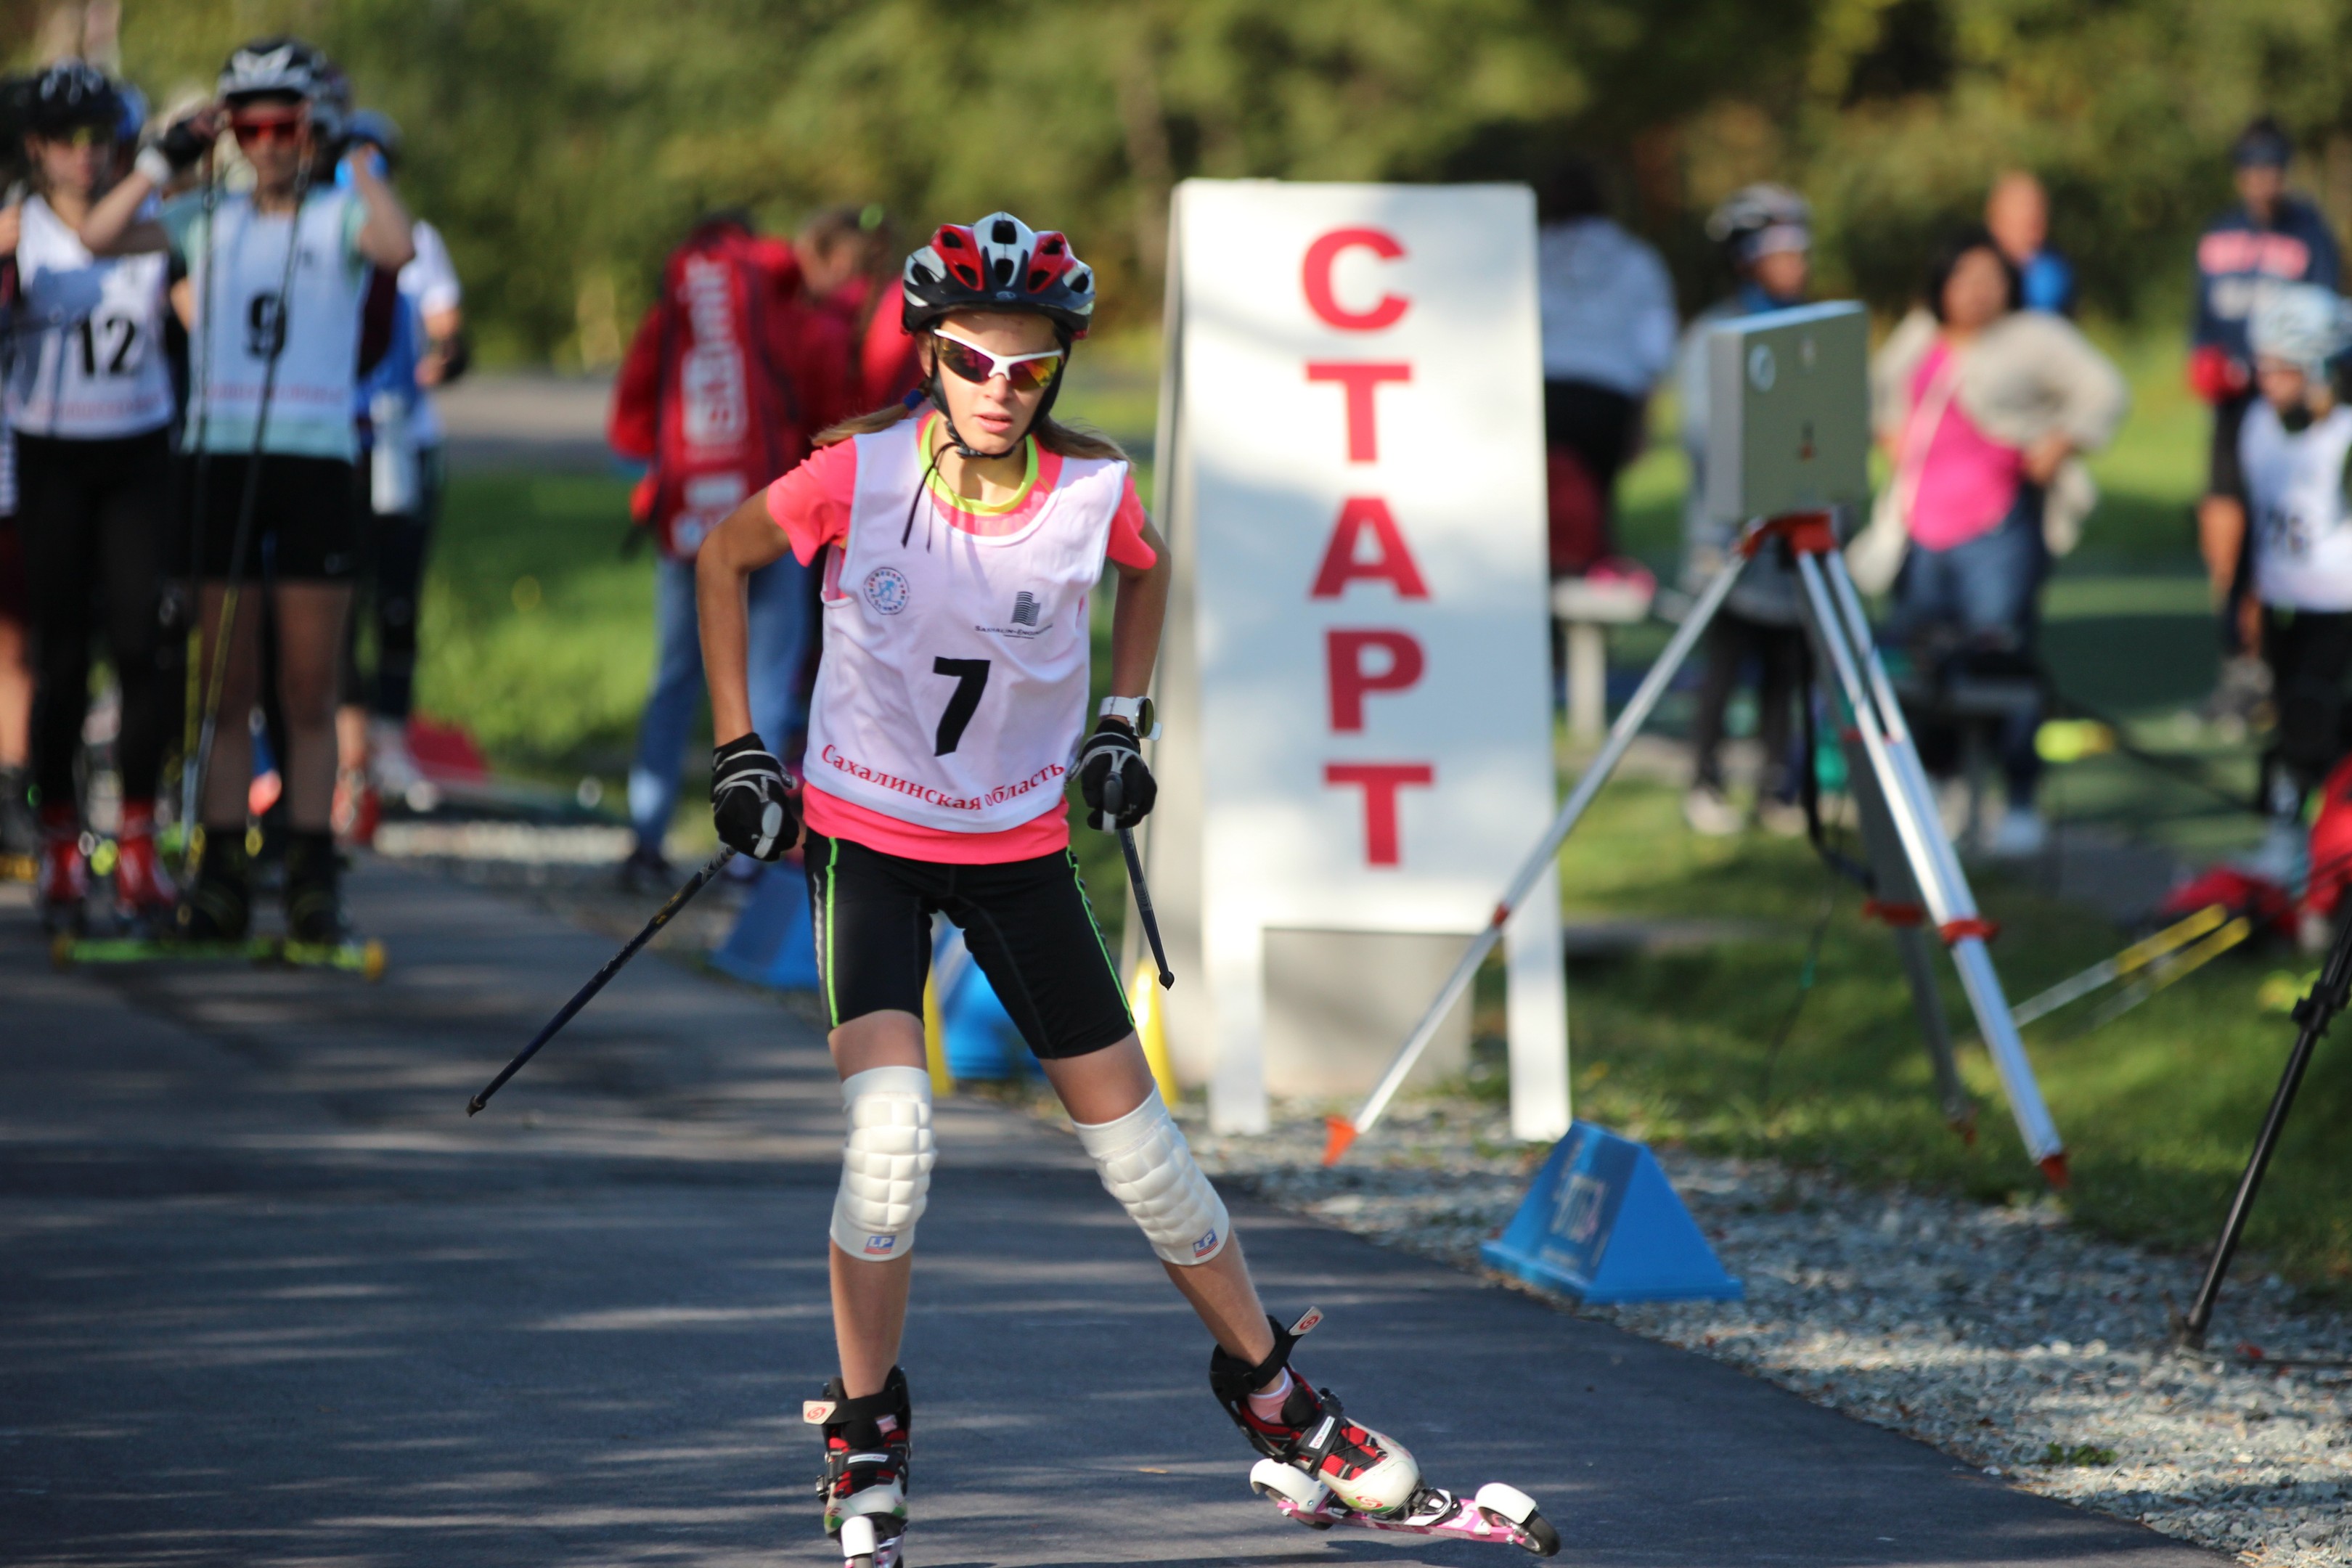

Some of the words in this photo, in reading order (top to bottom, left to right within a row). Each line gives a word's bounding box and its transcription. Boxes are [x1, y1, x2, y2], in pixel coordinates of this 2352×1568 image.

[77, 317, 136, 376] 12
[245, 293, 287, 357] 9
[1300, 226, 1434, 867] СТАРТ
[933, 656, 991, 757] 7
[822, 744, 981, 810] Сахалинская
[868, 1237, 892, 1248] LP
[1195, 1233, 1213, 1251] LP
